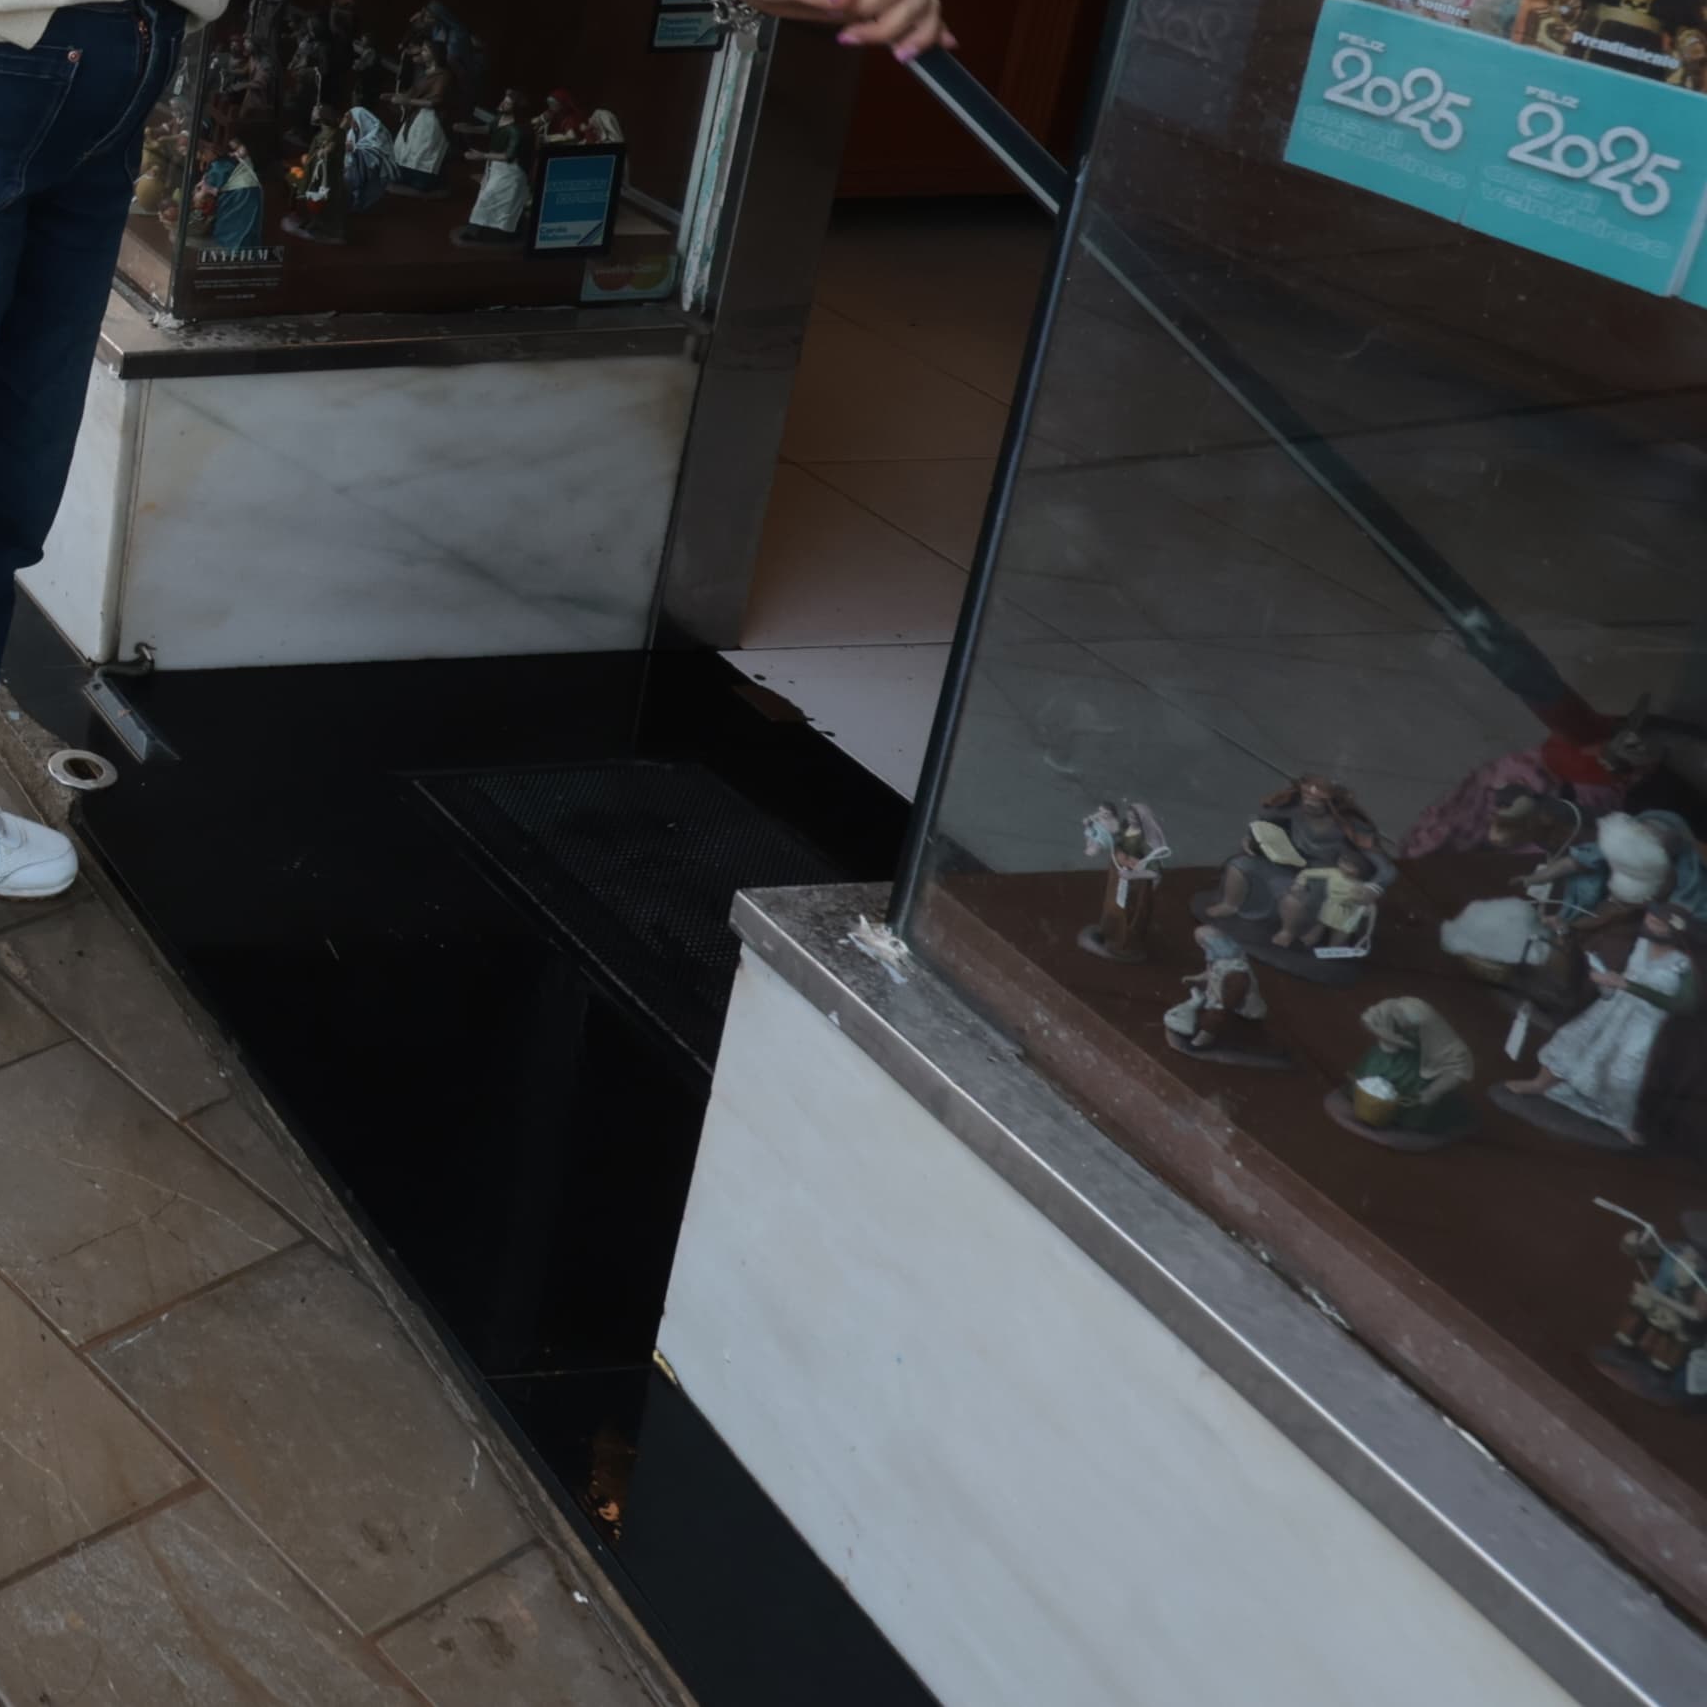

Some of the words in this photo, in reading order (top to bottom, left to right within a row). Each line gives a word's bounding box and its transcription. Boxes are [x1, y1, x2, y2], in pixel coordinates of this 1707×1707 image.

[1323, 46, 1473, 151] 2025
[1571, 31, 1681, 70] Prendimiento
[1506, 101, 1683, 217] 2025
